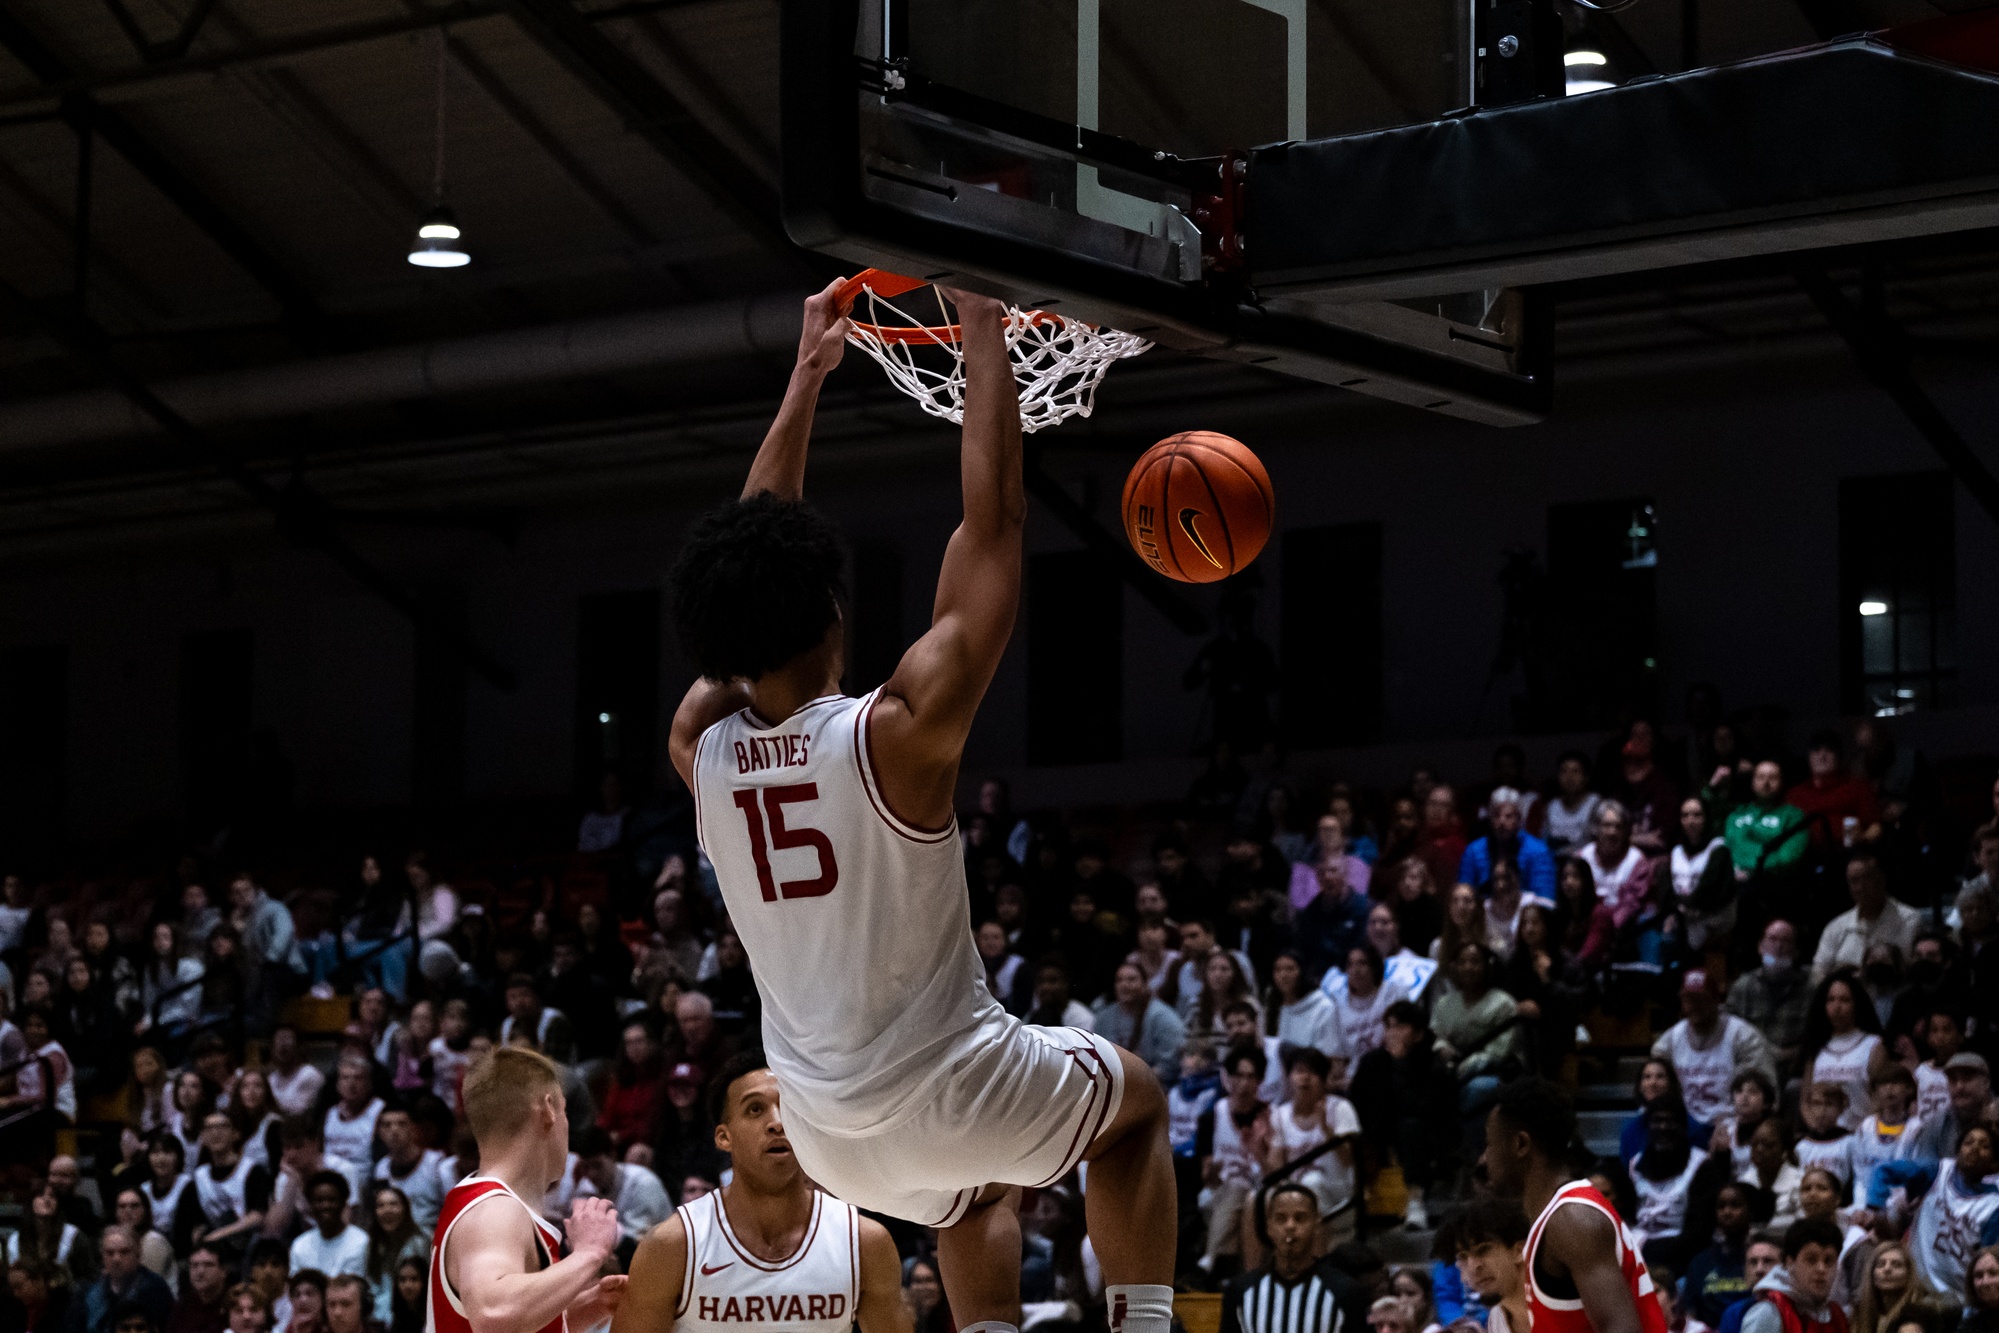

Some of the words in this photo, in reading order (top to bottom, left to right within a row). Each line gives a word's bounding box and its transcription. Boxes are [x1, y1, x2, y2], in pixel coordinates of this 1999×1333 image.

[1139, 504, 1170, 574] ELITE
[733, 734, 811, 775] BATTIES
[733, 782, 839, 902] 15
[698, 1293, 847, 1323] HARVARD
